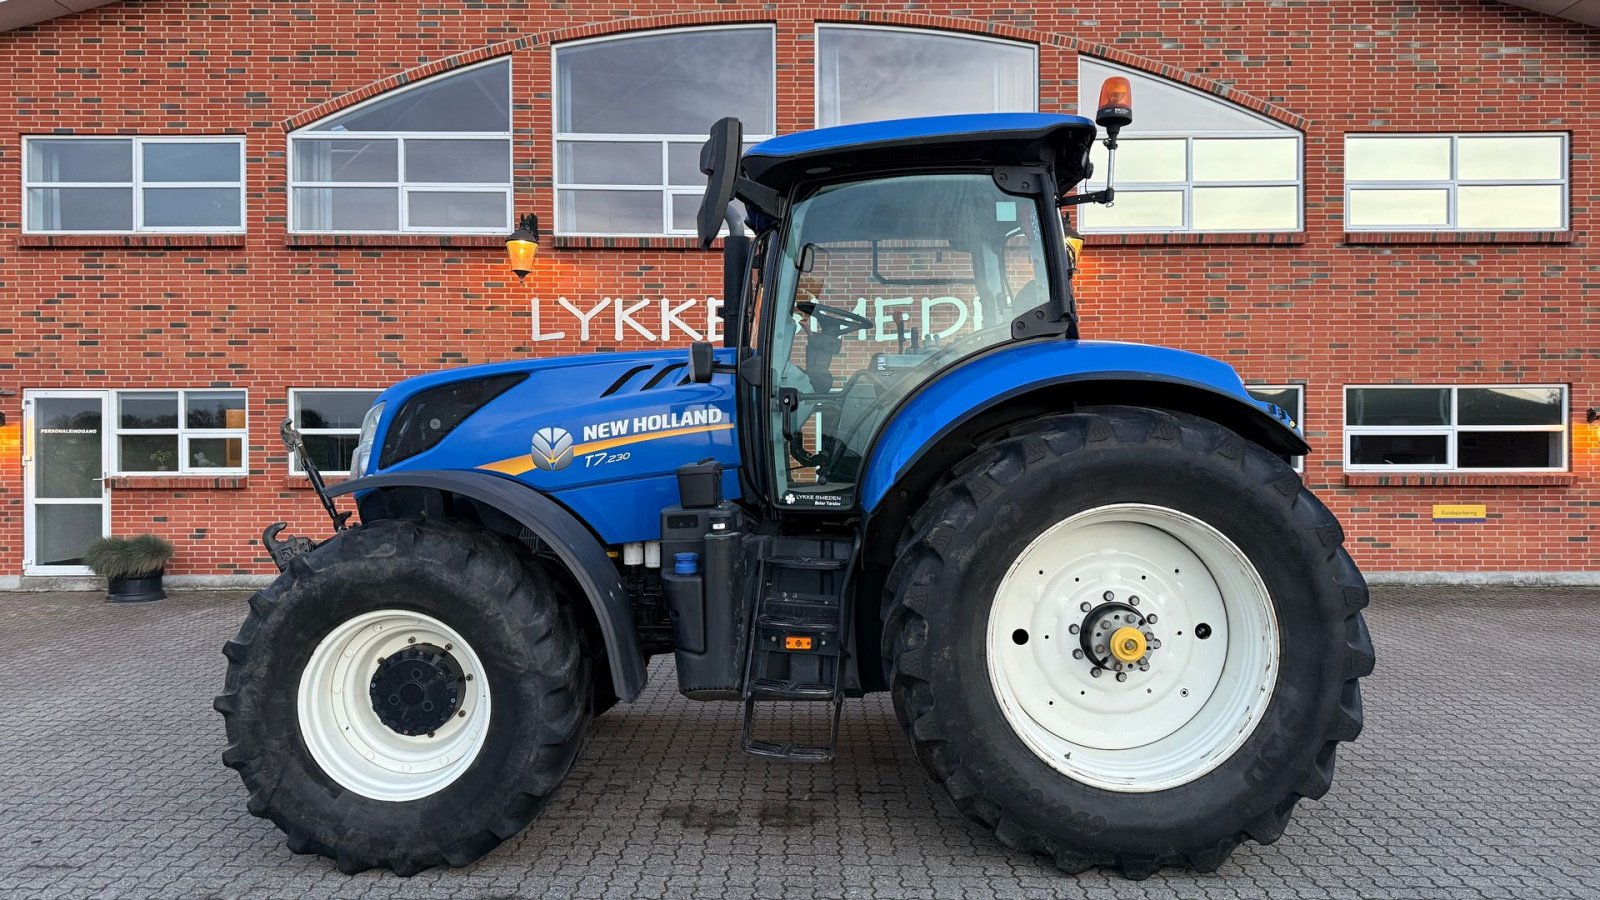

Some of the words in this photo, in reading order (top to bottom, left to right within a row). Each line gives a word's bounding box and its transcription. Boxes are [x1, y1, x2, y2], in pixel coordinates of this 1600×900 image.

[583, 419, 629, 441] NEW
[633, 408, 722, 433] HOLLAND
[584, 452, 631, 468] T7.230
